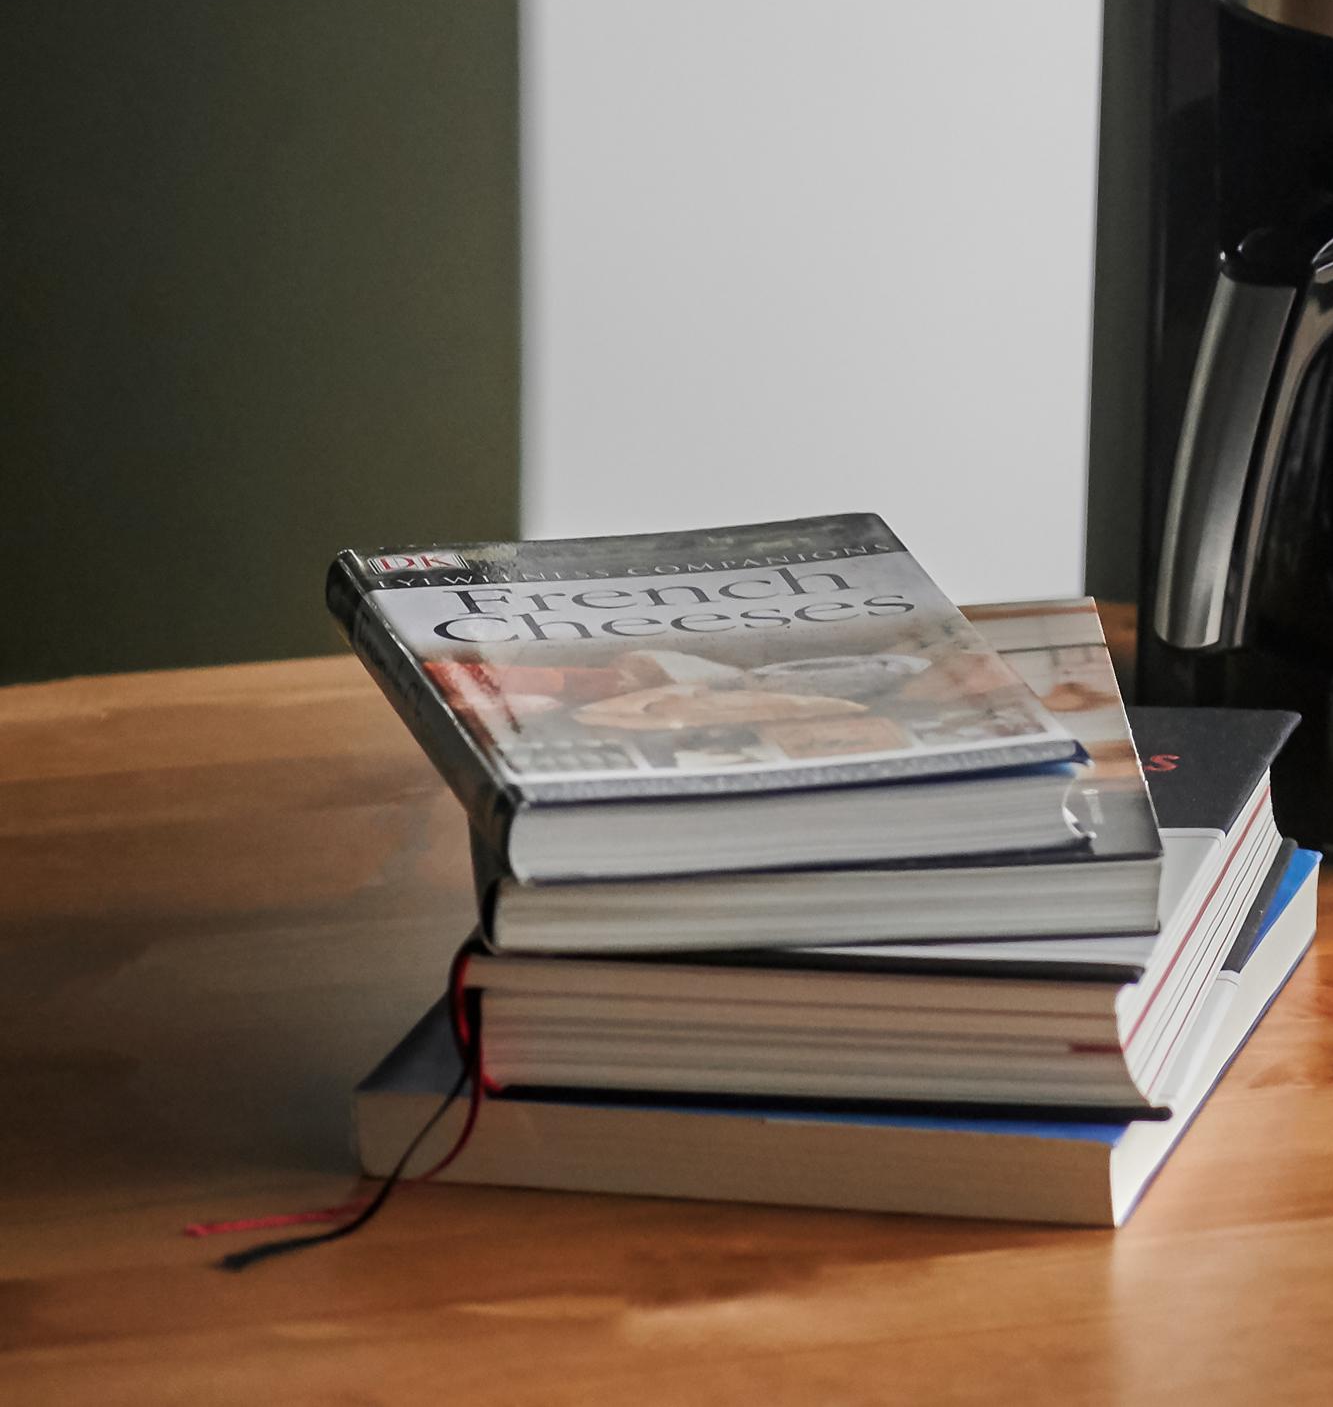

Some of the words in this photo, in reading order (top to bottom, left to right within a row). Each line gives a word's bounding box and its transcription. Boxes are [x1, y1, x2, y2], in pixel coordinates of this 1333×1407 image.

[379, 554, 451, 571] DK
[626, 543, 890, 577] COMPANIONS
[443, 567, 860, 616] French
[432, 595, 915, 643] Cheeses
